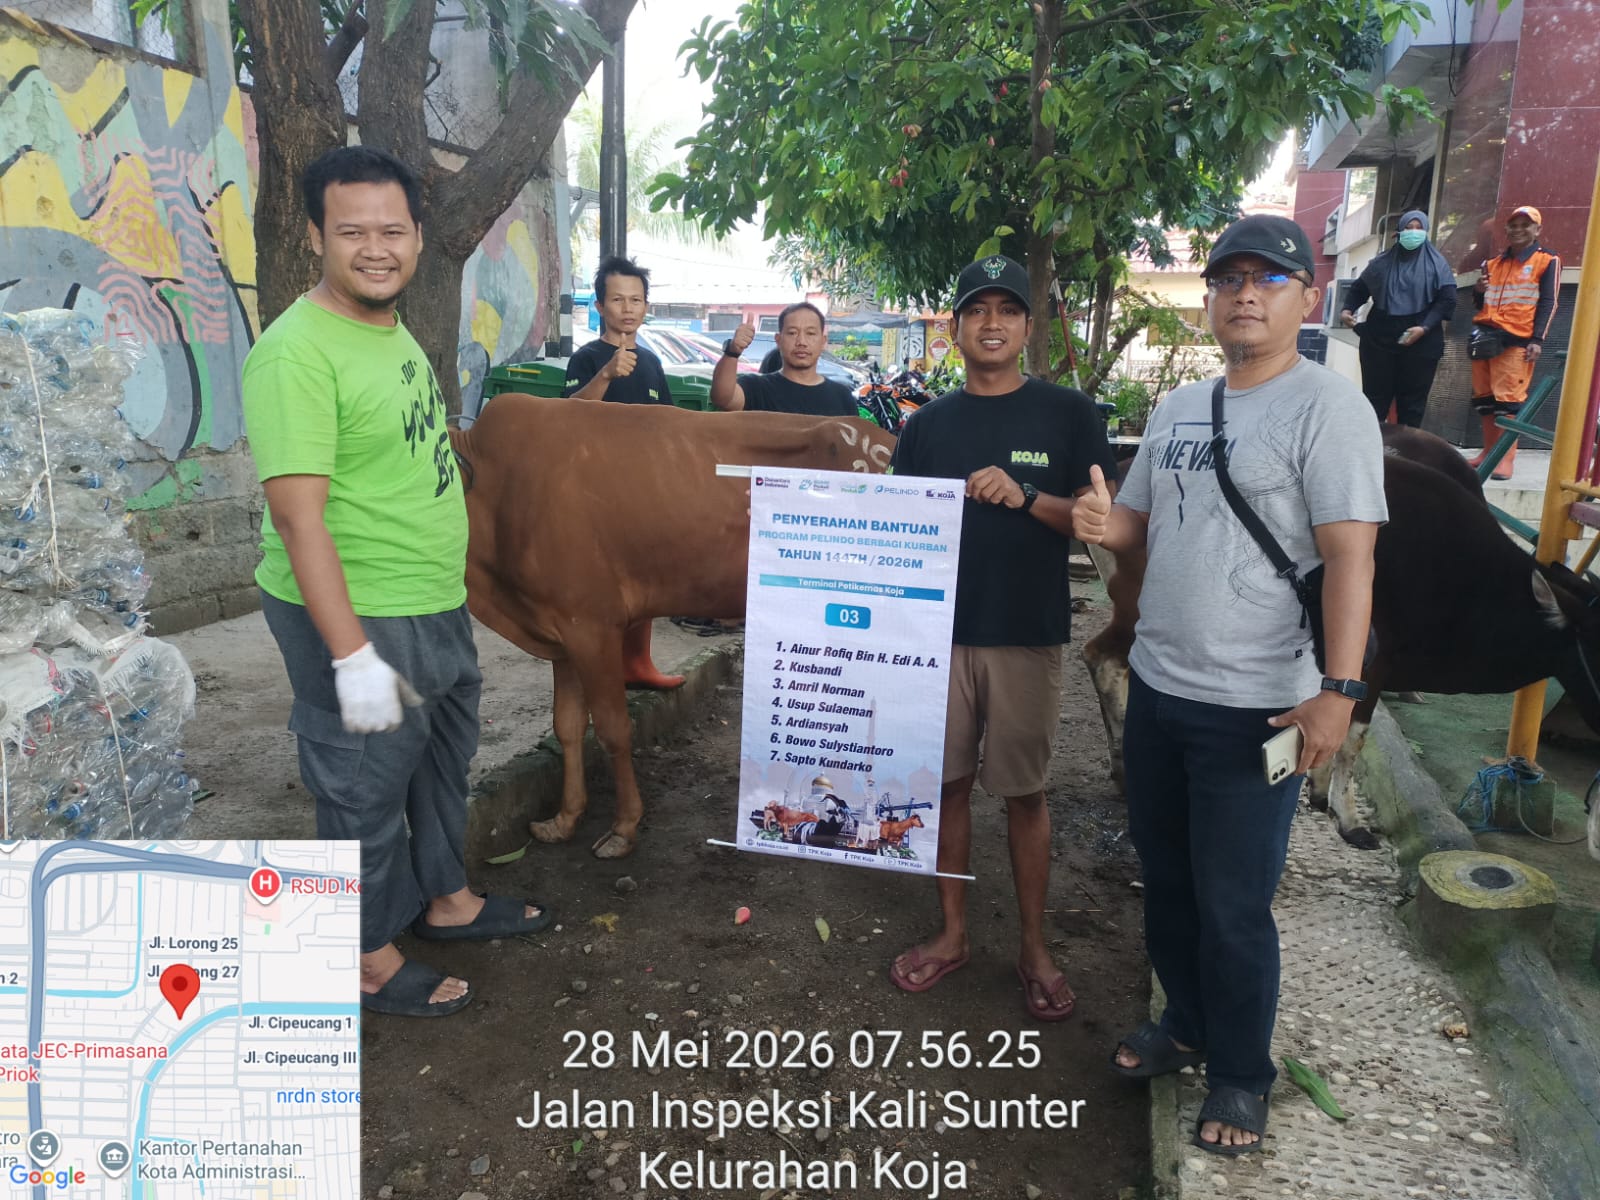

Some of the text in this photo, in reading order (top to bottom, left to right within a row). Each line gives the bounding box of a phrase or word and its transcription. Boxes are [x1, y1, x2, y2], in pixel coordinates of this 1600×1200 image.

[1011, 450, 1049, 464] KOJA
[884, 487, 920, 496] PELINDO
[772, 513, 939, 536] PENYERAHAN BANTUAN
[758, 530, 948, 553] PROGRAM PELINDO BERBAGI KURBAN
[778, 548, 923, 569] TAHUN 1447H / 2026M
[799, 578, 905, 597] Terminal Petikemas Koja
[839, 608, 860, 625] 03
[776, 641, 939, 669] 1. Ainur Rofiq Bin H. Edi A. A.
[773, 659, 842, 677] 2. Kusbandi
[772, 678, 865, 698] 3. Amril Norman
[771, 696, 873, 718] 4. Usup Sulaeman
[770, 714, 849, 734] 5. Ardiansyah
[770, 732, 894, 757] 6. Bowo Sulystiantoro
[769, 750, 873, 773] 7. Sapto Kundarko
